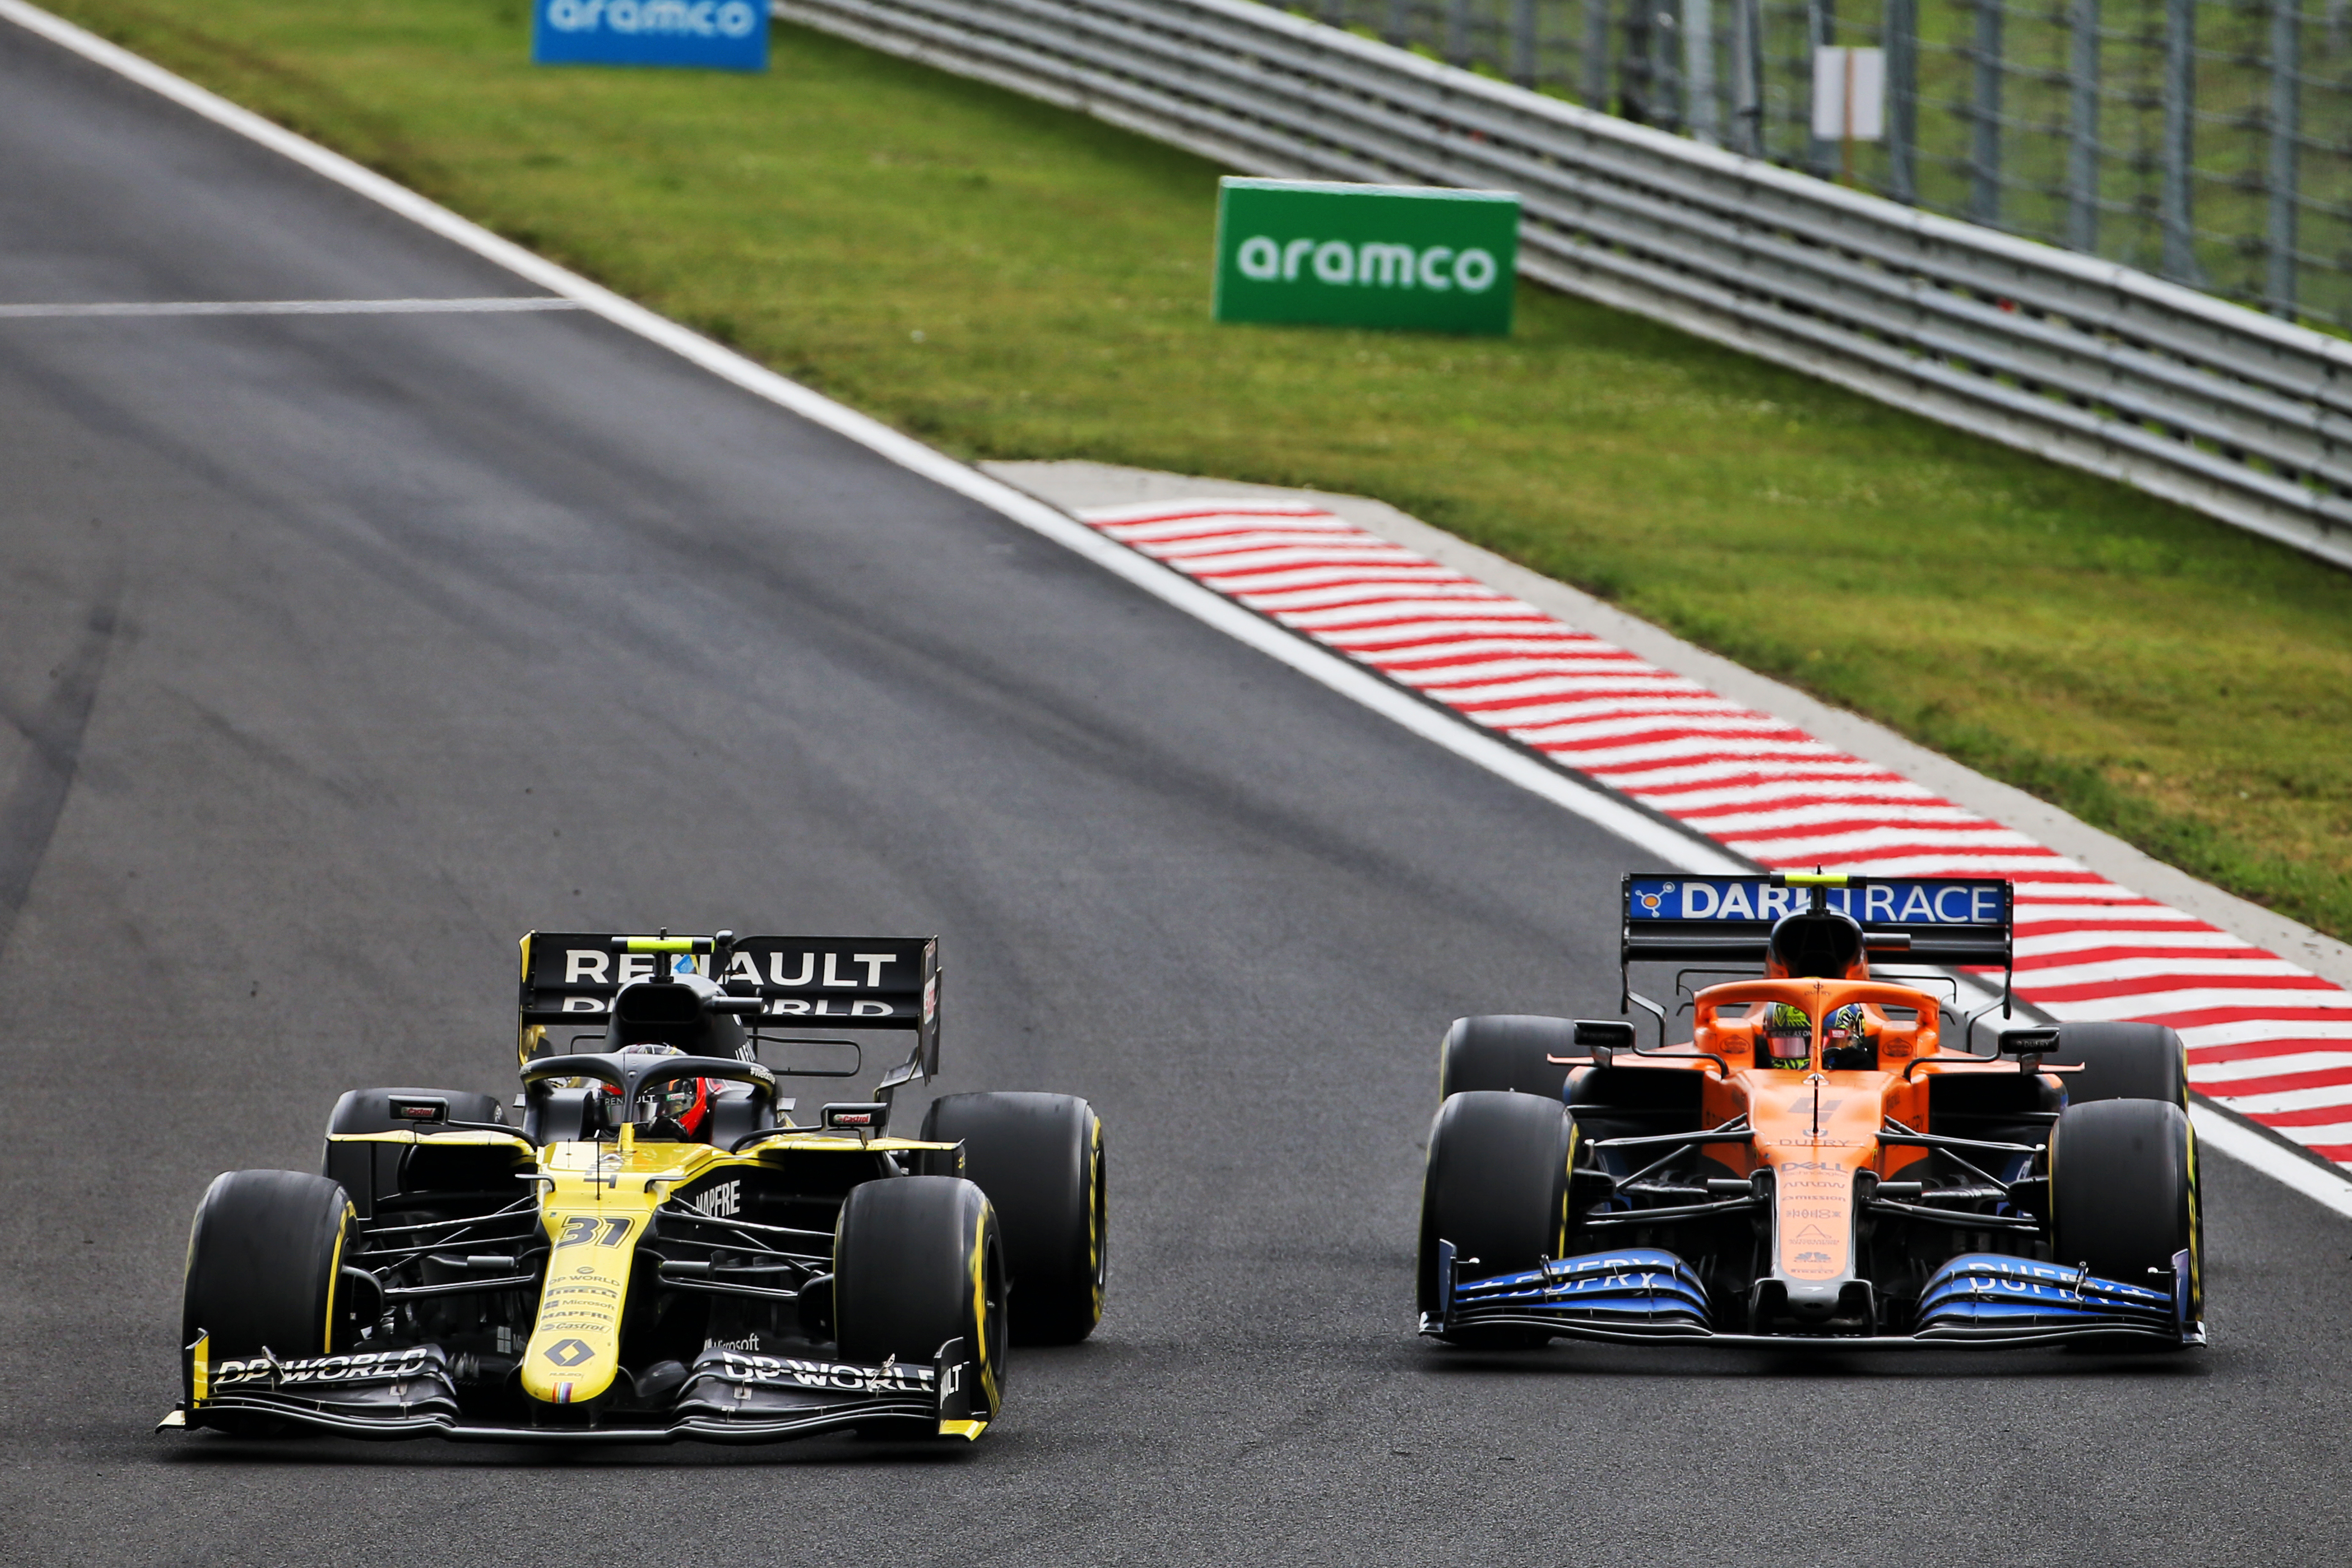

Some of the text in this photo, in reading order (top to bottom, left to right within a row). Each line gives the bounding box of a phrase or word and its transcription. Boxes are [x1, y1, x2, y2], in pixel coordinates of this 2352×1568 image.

[546, 0, 756, 39] aramco
[1237, 234, 1497, 294] aramco
[561, 997, 614, 1012] D
[604, 1094, 655, 1105] RENLT
[407, 1107, 434, 1117] Castrol
[1788, 1097, 1843, 1123] 4
[843, 1115, 869, 1123] Castrol
[1781, 1161, 1848, 1174] DELL
[553, 1215, 635, 1250] 31
[548, 1275, 620, 1287] DP WORLD
[546, 1286, 618, 1299] PIRELLI
[562, 1300, 615, 1311] Microsoft
[541, 1311, 613, 1322] MAPFRE
[555, 1322, 605, 1332] Castrol
[213, 1348, 428, 1384] DP WORLD
[723, 1351, 780, 1381] DP
